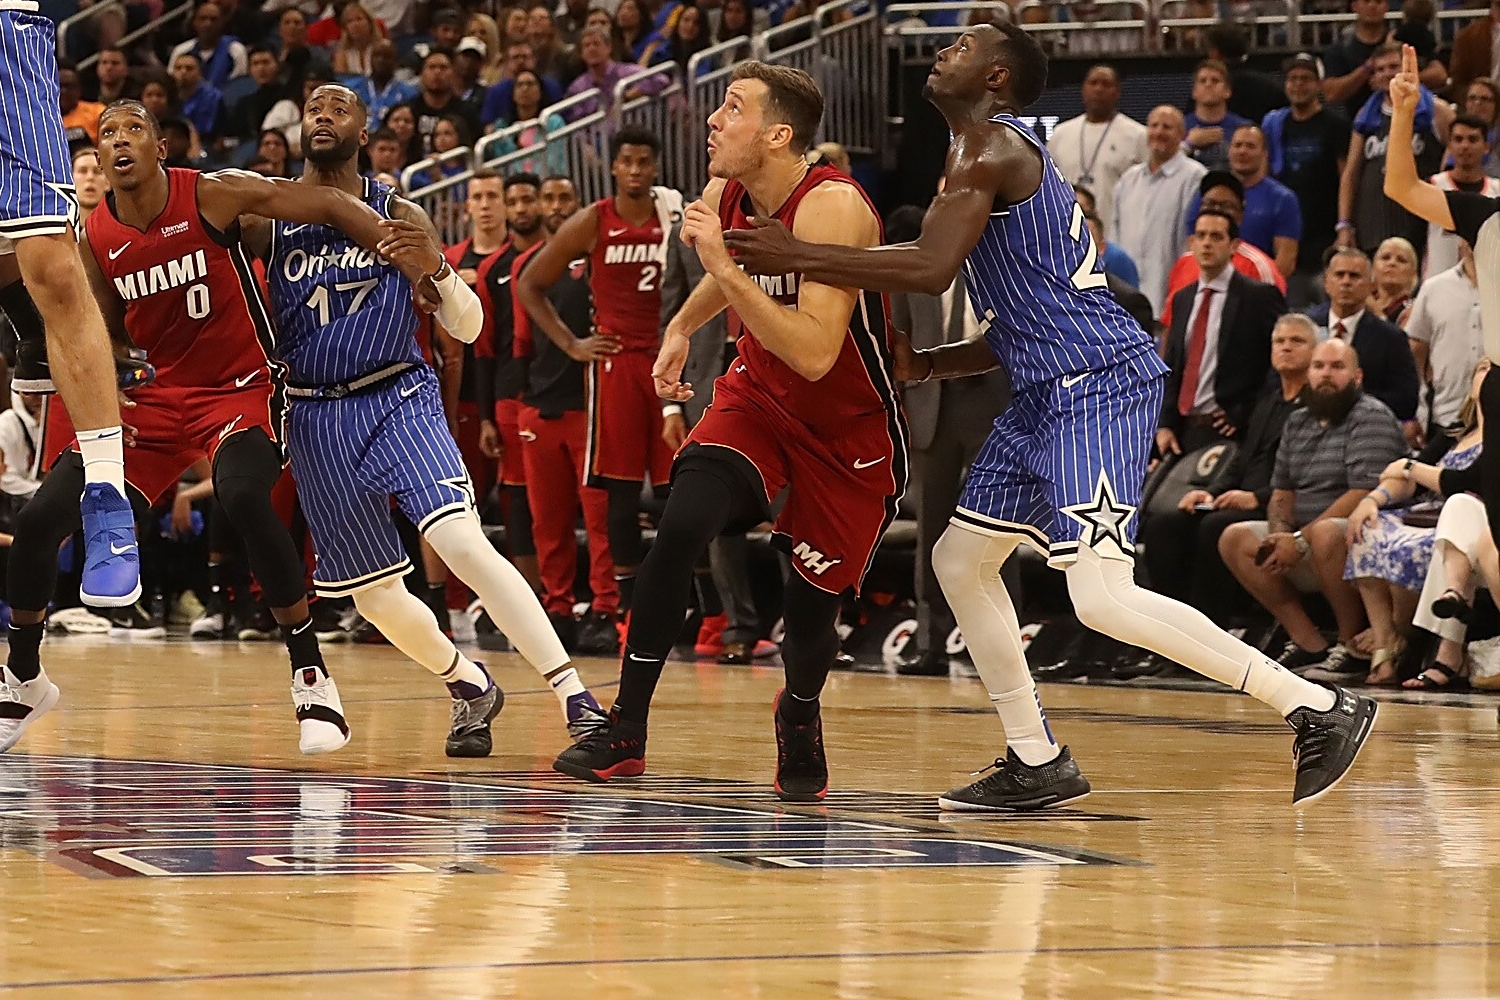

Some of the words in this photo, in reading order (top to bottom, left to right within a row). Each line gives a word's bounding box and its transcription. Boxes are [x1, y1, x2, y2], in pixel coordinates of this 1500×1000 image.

[113, 248, 208, 301] MIAMI
[604, 243, 661, 265] MIAM
[186, 283, 211, 320] 0
[306, 277, 379, 327] 17
